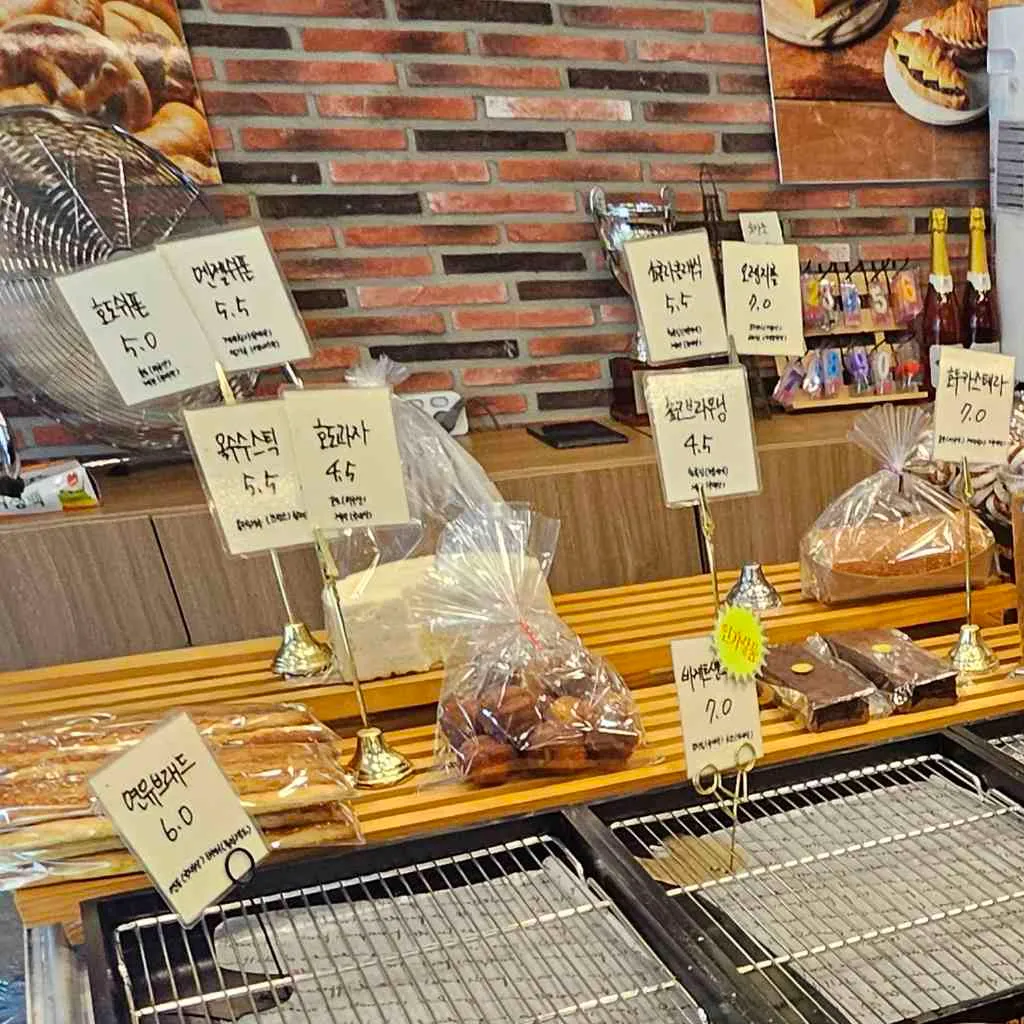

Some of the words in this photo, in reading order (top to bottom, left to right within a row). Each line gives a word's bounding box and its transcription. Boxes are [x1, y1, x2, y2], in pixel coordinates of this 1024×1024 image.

[215, 296, 249, 320] 5.5
[665, 291, 692, 314] 5.5
[748, 294, 771, 311] 7.0
[120, 332, 157, 358] 5.0
[960, 402, 988, 424] 7.0
[215, 427, 280, 463] 옥수수스틱
[683, 433, 713, 456] 4.5
[243, 470, 279, 496] 5.5
[325, 459, 357, 483] 4.5
[704, 697, 734, 724] 7.0
[159, 804, 194, 843] 6.0
